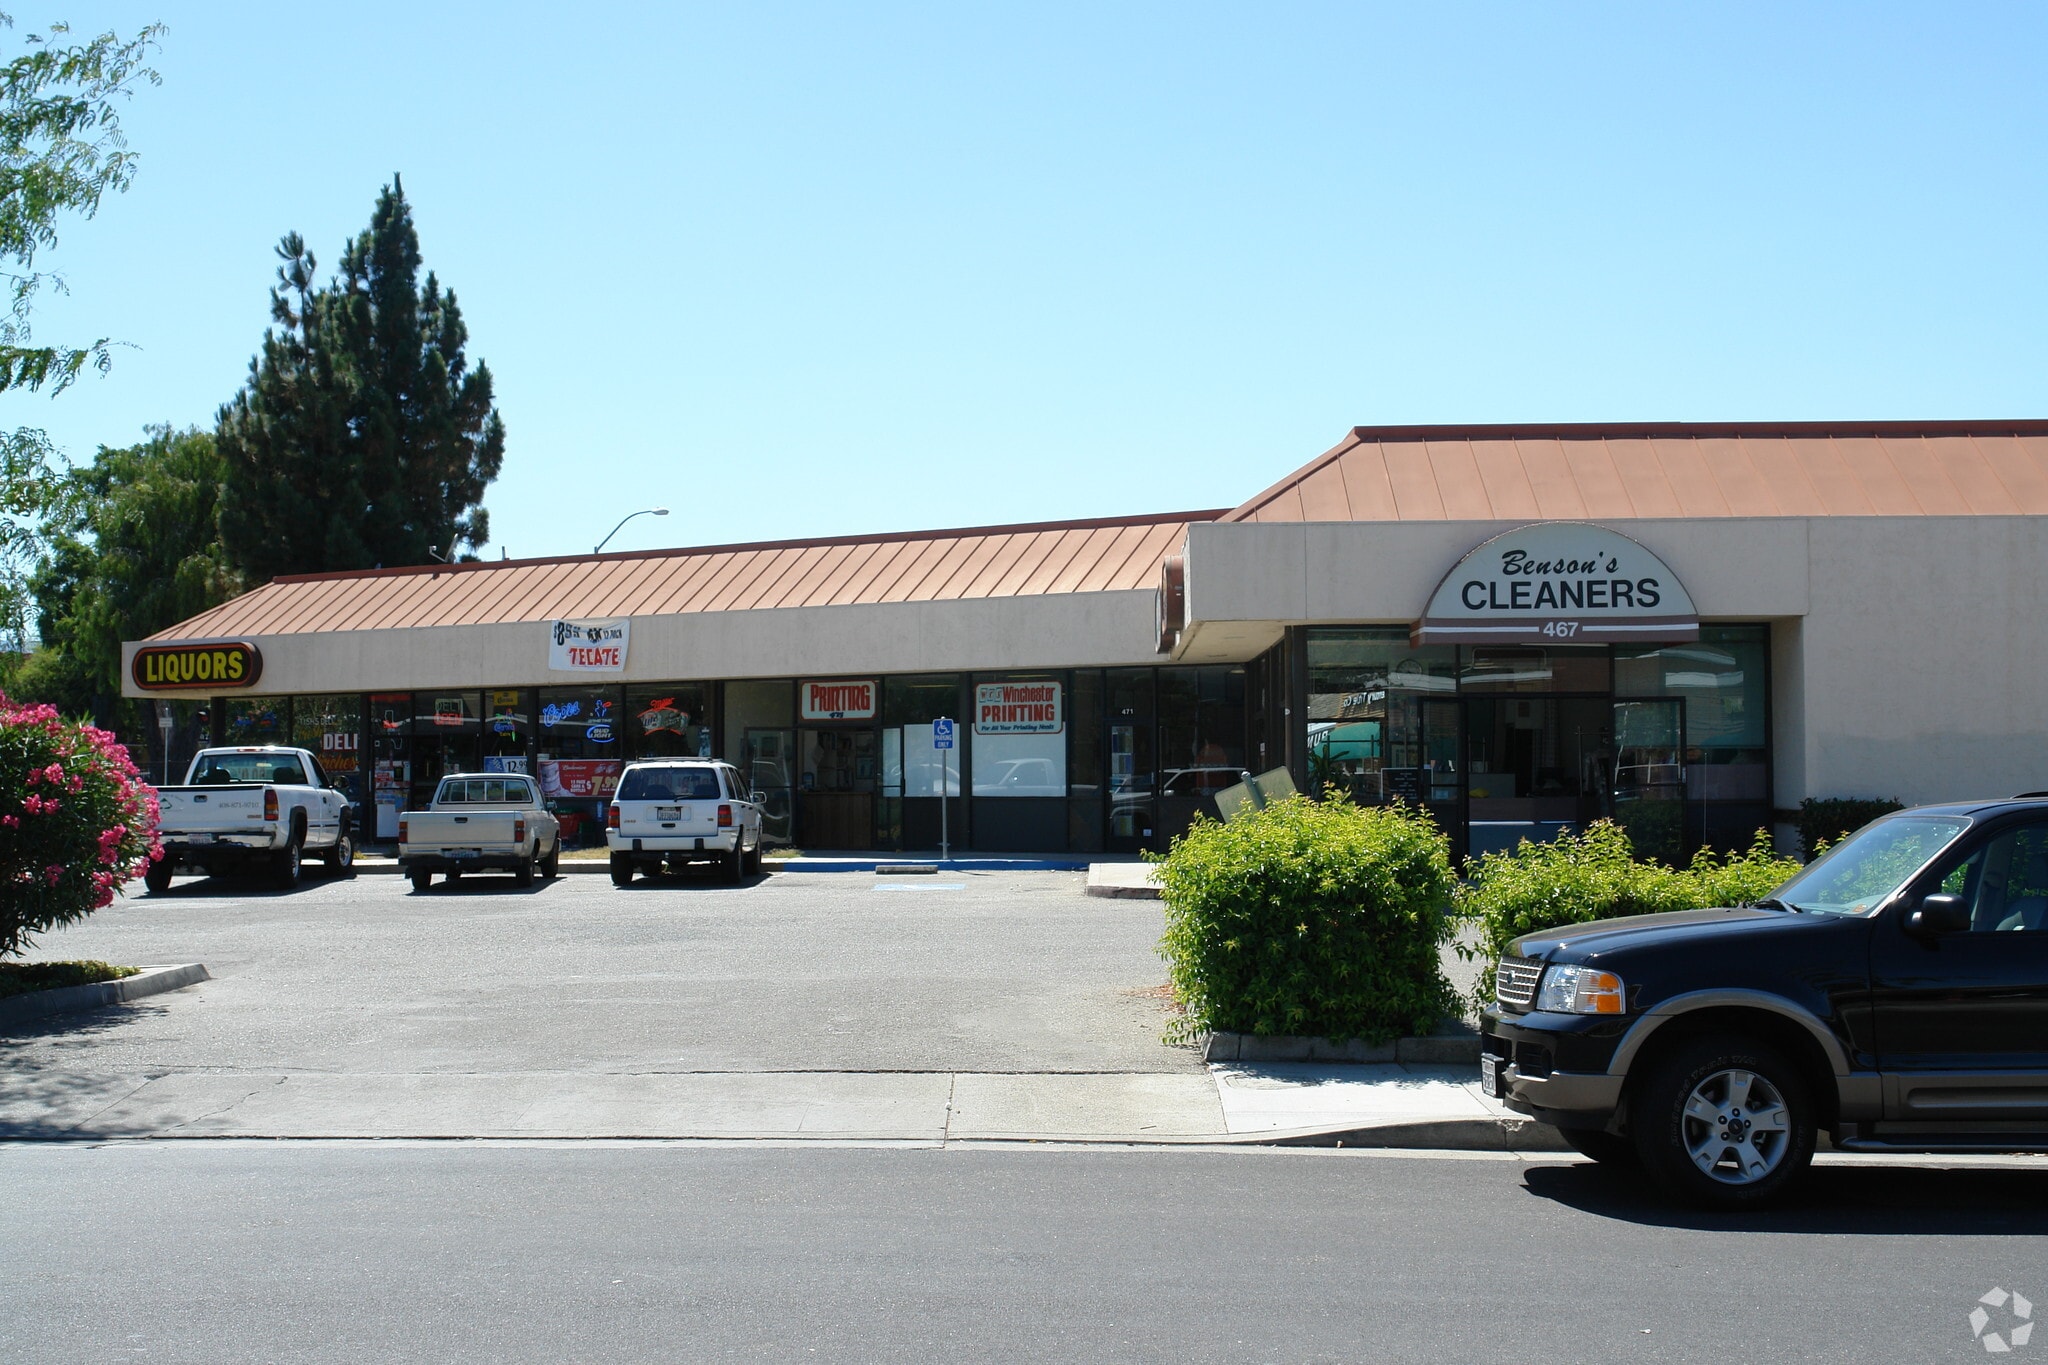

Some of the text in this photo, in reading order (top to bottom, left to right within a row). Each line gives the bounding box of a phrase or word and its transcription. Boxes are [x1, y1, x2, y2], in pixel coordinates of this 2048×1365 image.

[1502, 550, 1619, 576] Benson's
[1462, 578, 1661, 610] CLEANERS
[1543, 621, 1579, 637] 467
[569, 647, 619, 666] TECATE
[146, 651, 243, 683] LIQUORS
[1002, 684, 1056, 703] Winchester
[543, 701, 580, 727] Coors
[981, 703, 1055, 722] PRINTING
[323, 733, 358, 750] DELI
